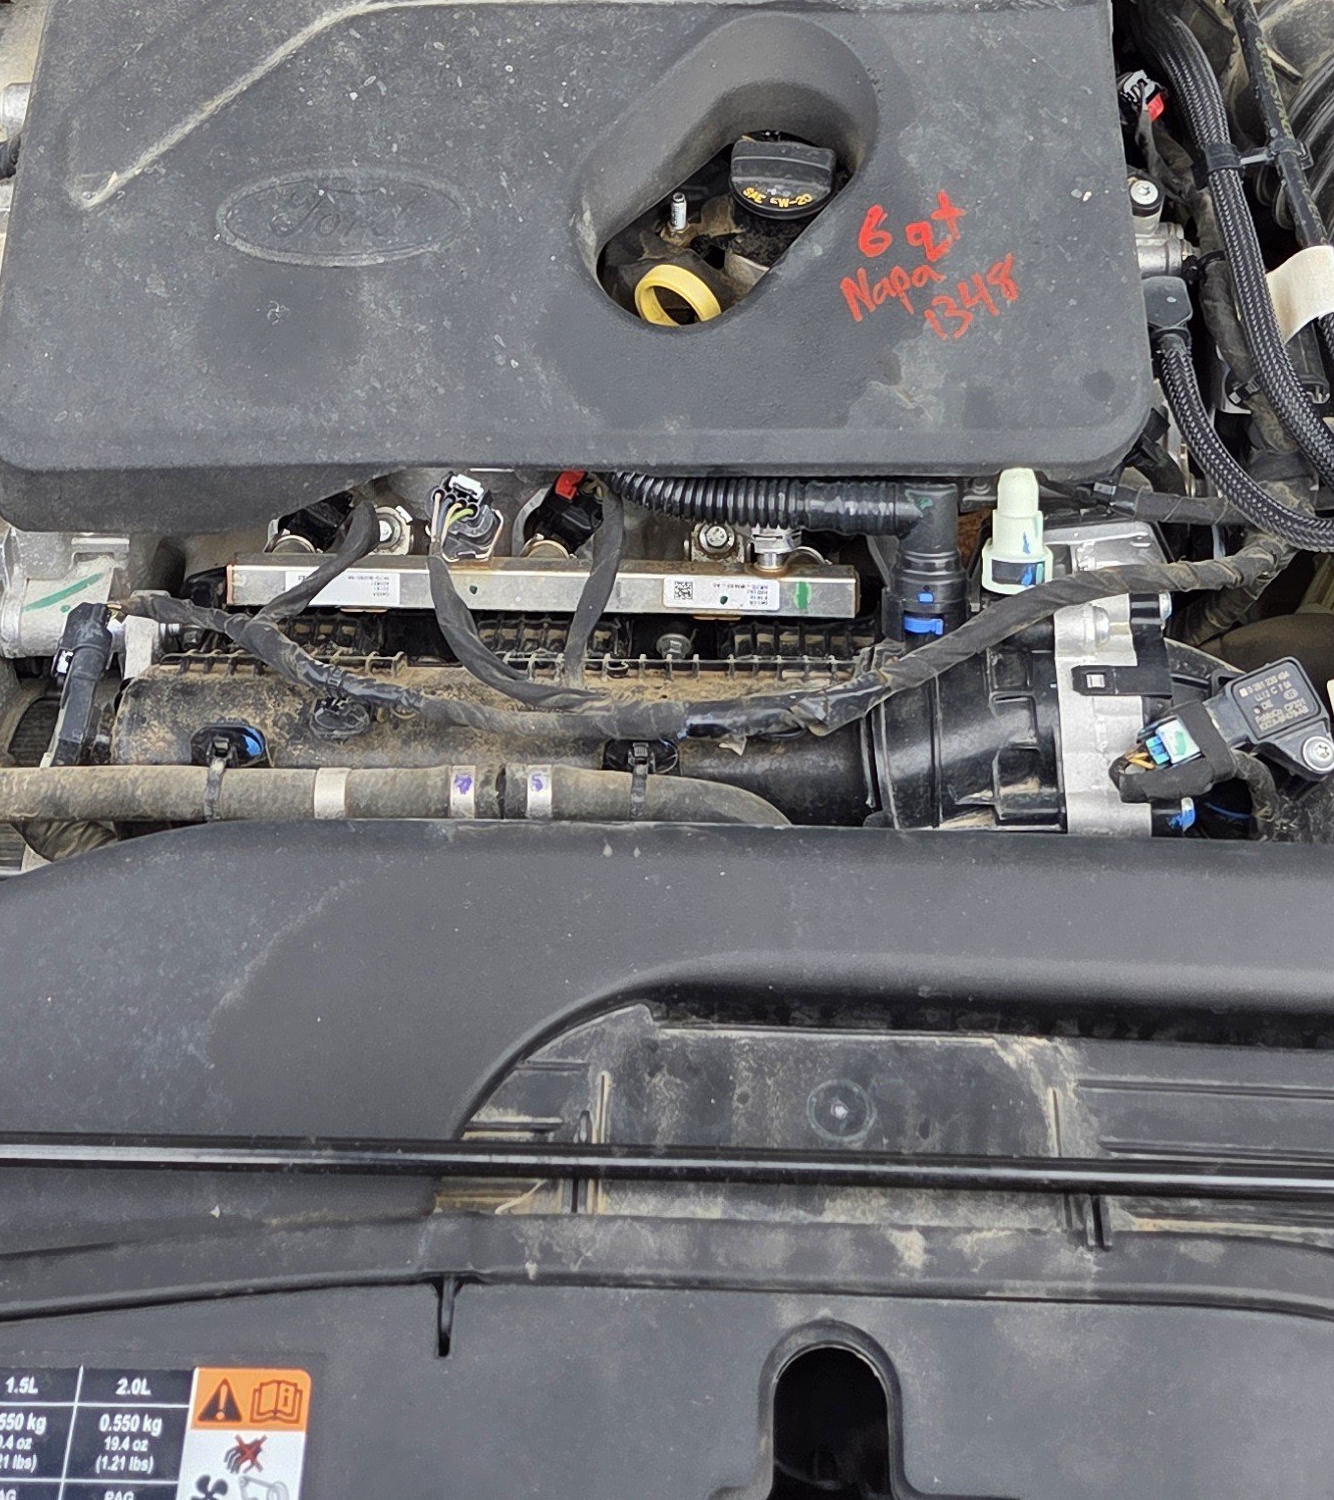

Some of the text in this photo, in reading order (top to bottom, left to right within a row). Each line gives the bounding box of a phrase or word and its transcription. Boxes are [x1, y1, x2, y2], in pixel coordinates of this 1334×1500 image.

[743, 187, 767, 204] SAE
[858, 204, 893, 258] 6
[840, 264, 947, 323] Napa
[923, 252, 1019, 340] 1348
[5, 1376, 39, 1395] 1.5L
[116, 1378, 152, 1396] 2.0L
[27, 1412, 47, 1436] kg
[99, 1413, 163, 1437] 0.550 kg
[16, 1437, 33, 1449] oz
[104, 1436, 149, 1451] 19.4 oz
[12, 1453, 38, 1473] lbs)
[95, 1455, 154, 1474] (1.21 lbs)
